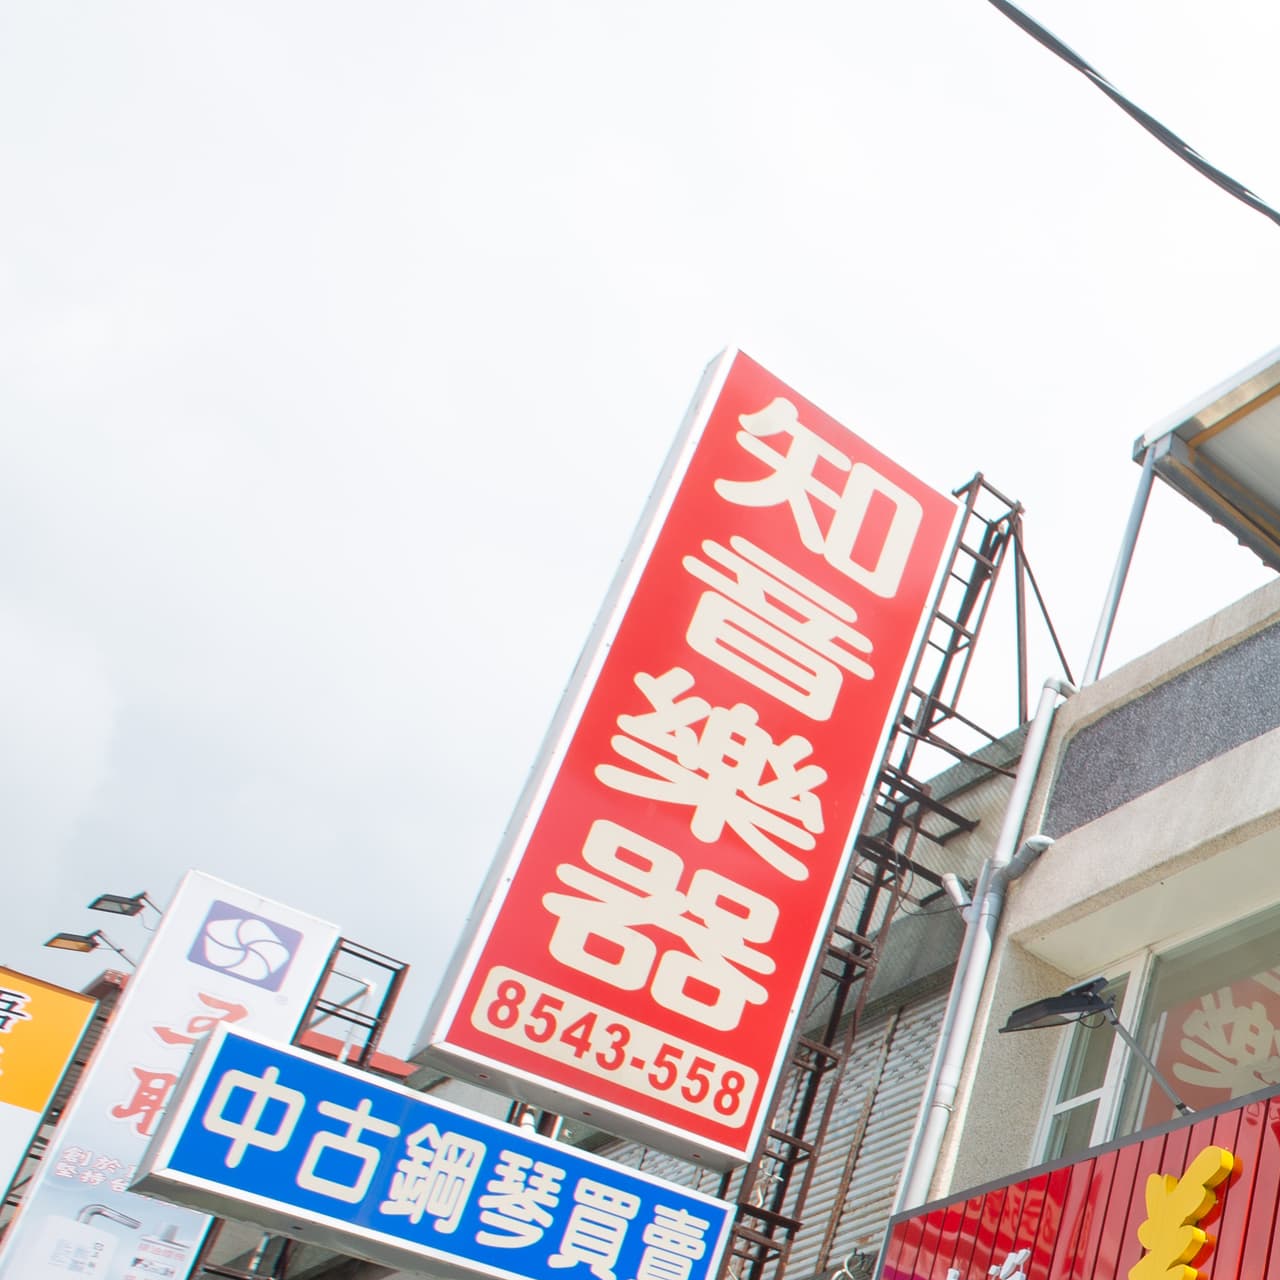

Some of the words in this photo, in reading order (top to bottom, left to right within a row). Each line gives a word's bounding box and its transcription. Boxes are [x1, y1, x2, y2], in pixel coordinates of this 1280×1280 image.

[542, 397, 924, 1032] 知音樂器
[487, 978, 747, 1117] 8543-558
